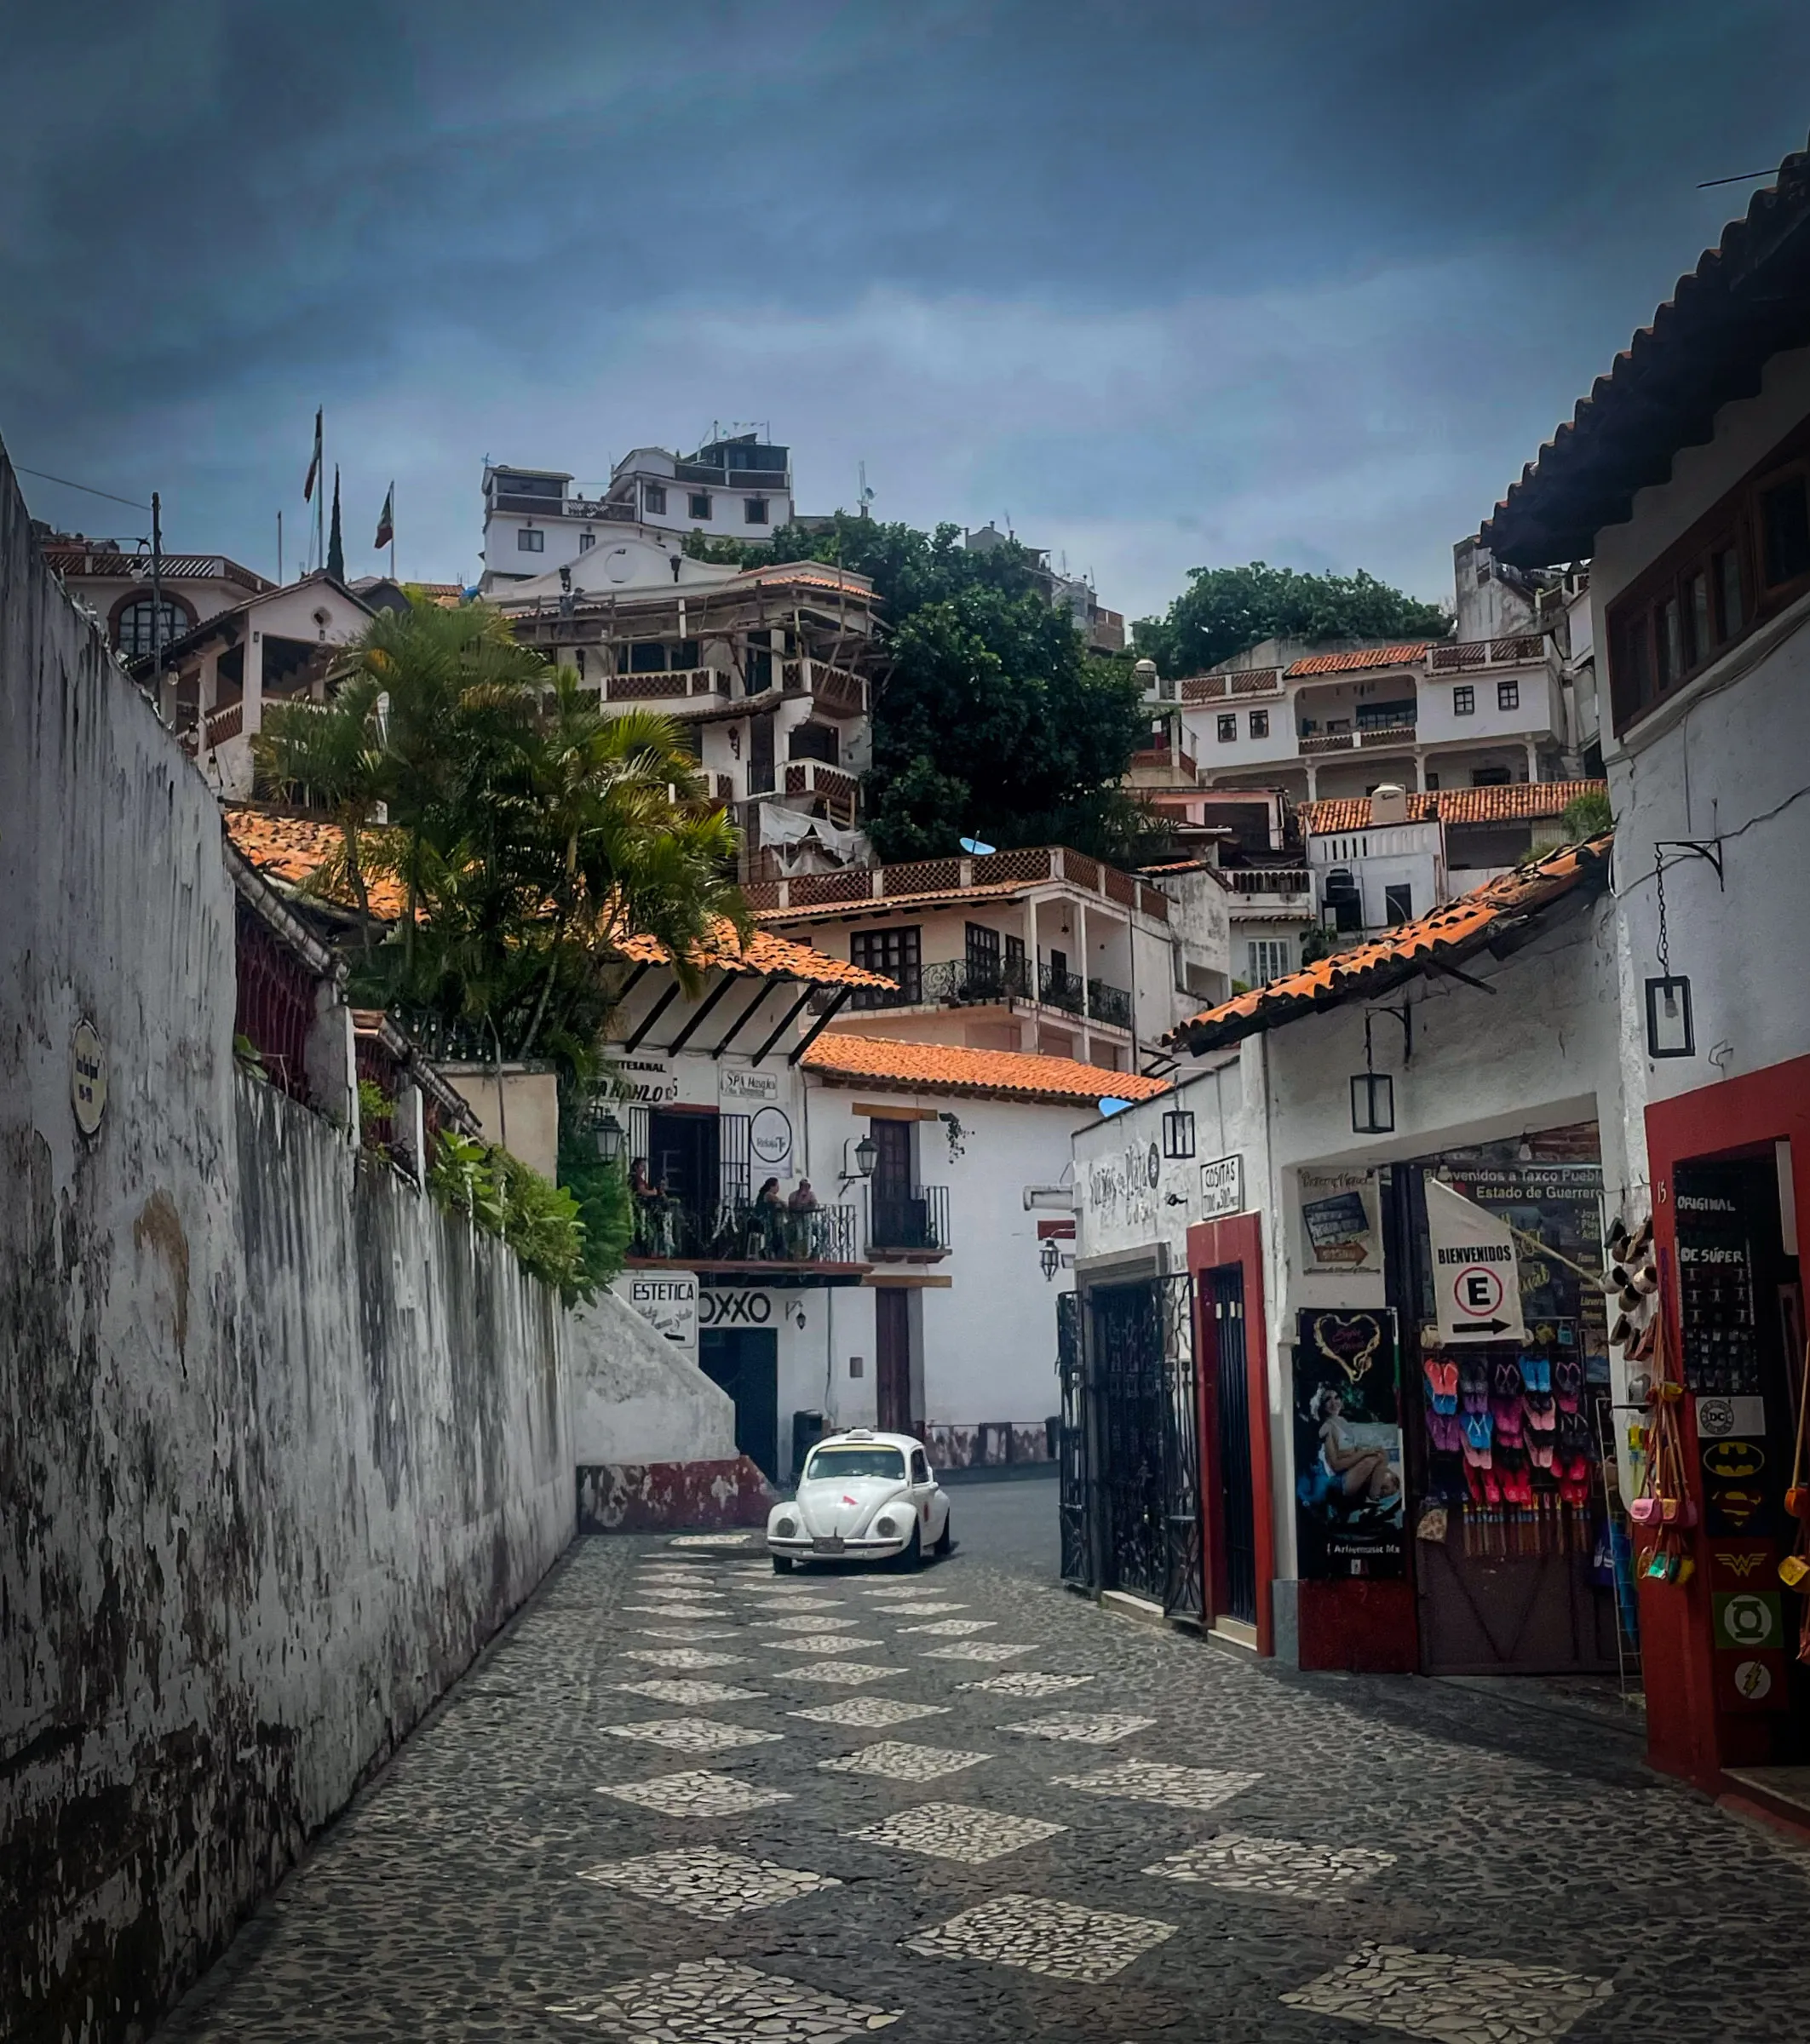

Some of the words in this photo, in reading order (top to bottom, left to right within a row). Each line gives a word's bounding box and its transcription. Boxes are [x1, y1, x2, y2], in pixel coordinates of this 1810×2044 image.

[608, 1059, 667, 1073] TESANAL
[1205, 1160, 1235, 1188] COSITAS
[1423, 1168, 1505, 1184] Bivenidos
[1520, 1169, 1558, 1182] Taxco
[1476, 1185, 1523, 1199] Estado
[1526, 1186, 1543, 1199] de
[1546, 1186, 1603, 1199] Guerrero
[1658, 1179, 1667, 1204] 15
[1438, 1245, 1512, 1264] BIENVENIDOS
[1701, 1246, 1744, 1264] SÚPER
[633, 1283, 694, 1300] ESTETICA
[1467, 1276, 1491, 1306] E
[698, 1290, 772, 1325] OXXO
[1709, 1412, 1725, 1421] DC
